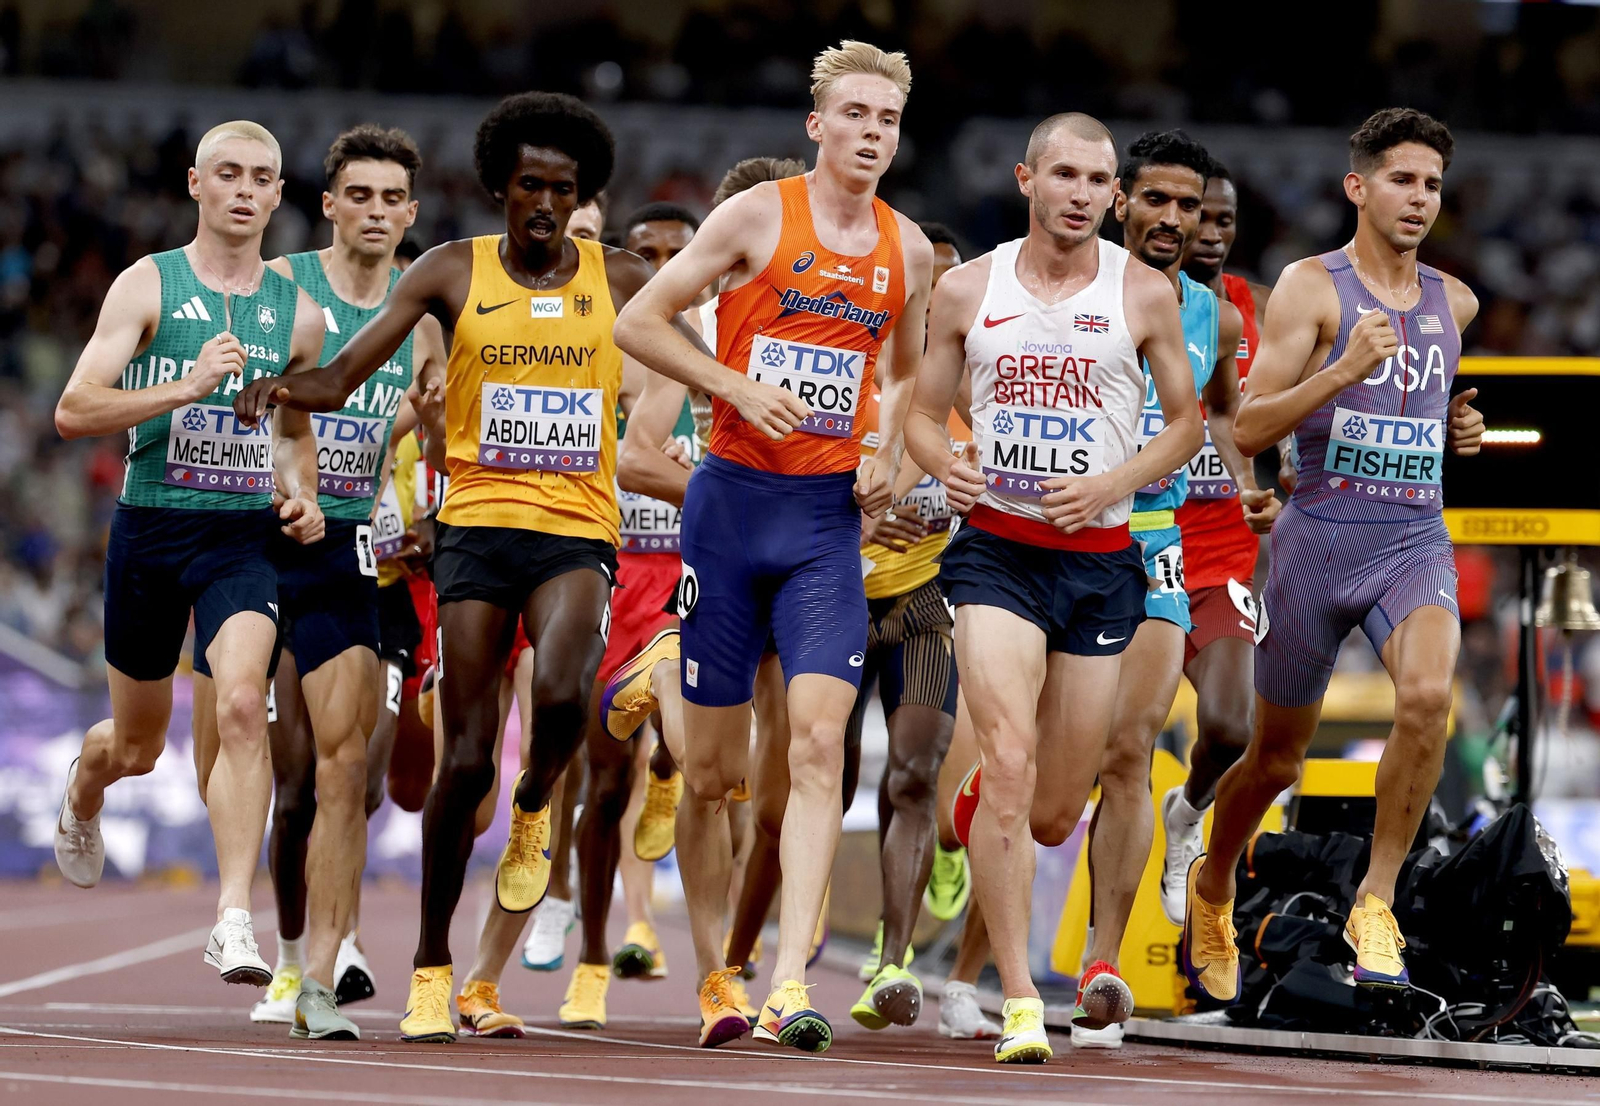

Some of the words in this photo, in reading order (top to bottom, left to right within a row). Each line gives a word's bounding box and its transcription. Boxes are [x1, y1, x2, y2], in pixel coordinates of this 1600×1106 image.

[819, 269, 864, 286] Staatsloterij
[532, 302, 562, 313] WGV
[779, 288, 889, 329] Nederland
[480, 344, 596, 367] GERMANY
[1016, 340, 1072, 354] Novuna
[787, 345, 855, 379] TDK
[996, 354, 1097, 384] GREAT
[515, 389, 594, 416] TDK
[993, 380, 1103, 409] BRITAIN
[312, 413, 383, 444] TDK
[486, 418, 596, 447] ABDILAAHI
[1014, 412, 1096, 442] TDK
[1369, 419, 1436, 447] TDK
[173, 437, 270, 468] McELHINNEY
[993, 441, 1089, 474] MILLS
[1334, 446, 1434, 480] FISHER
[1462, 515, 1550, 538] SEIKO
